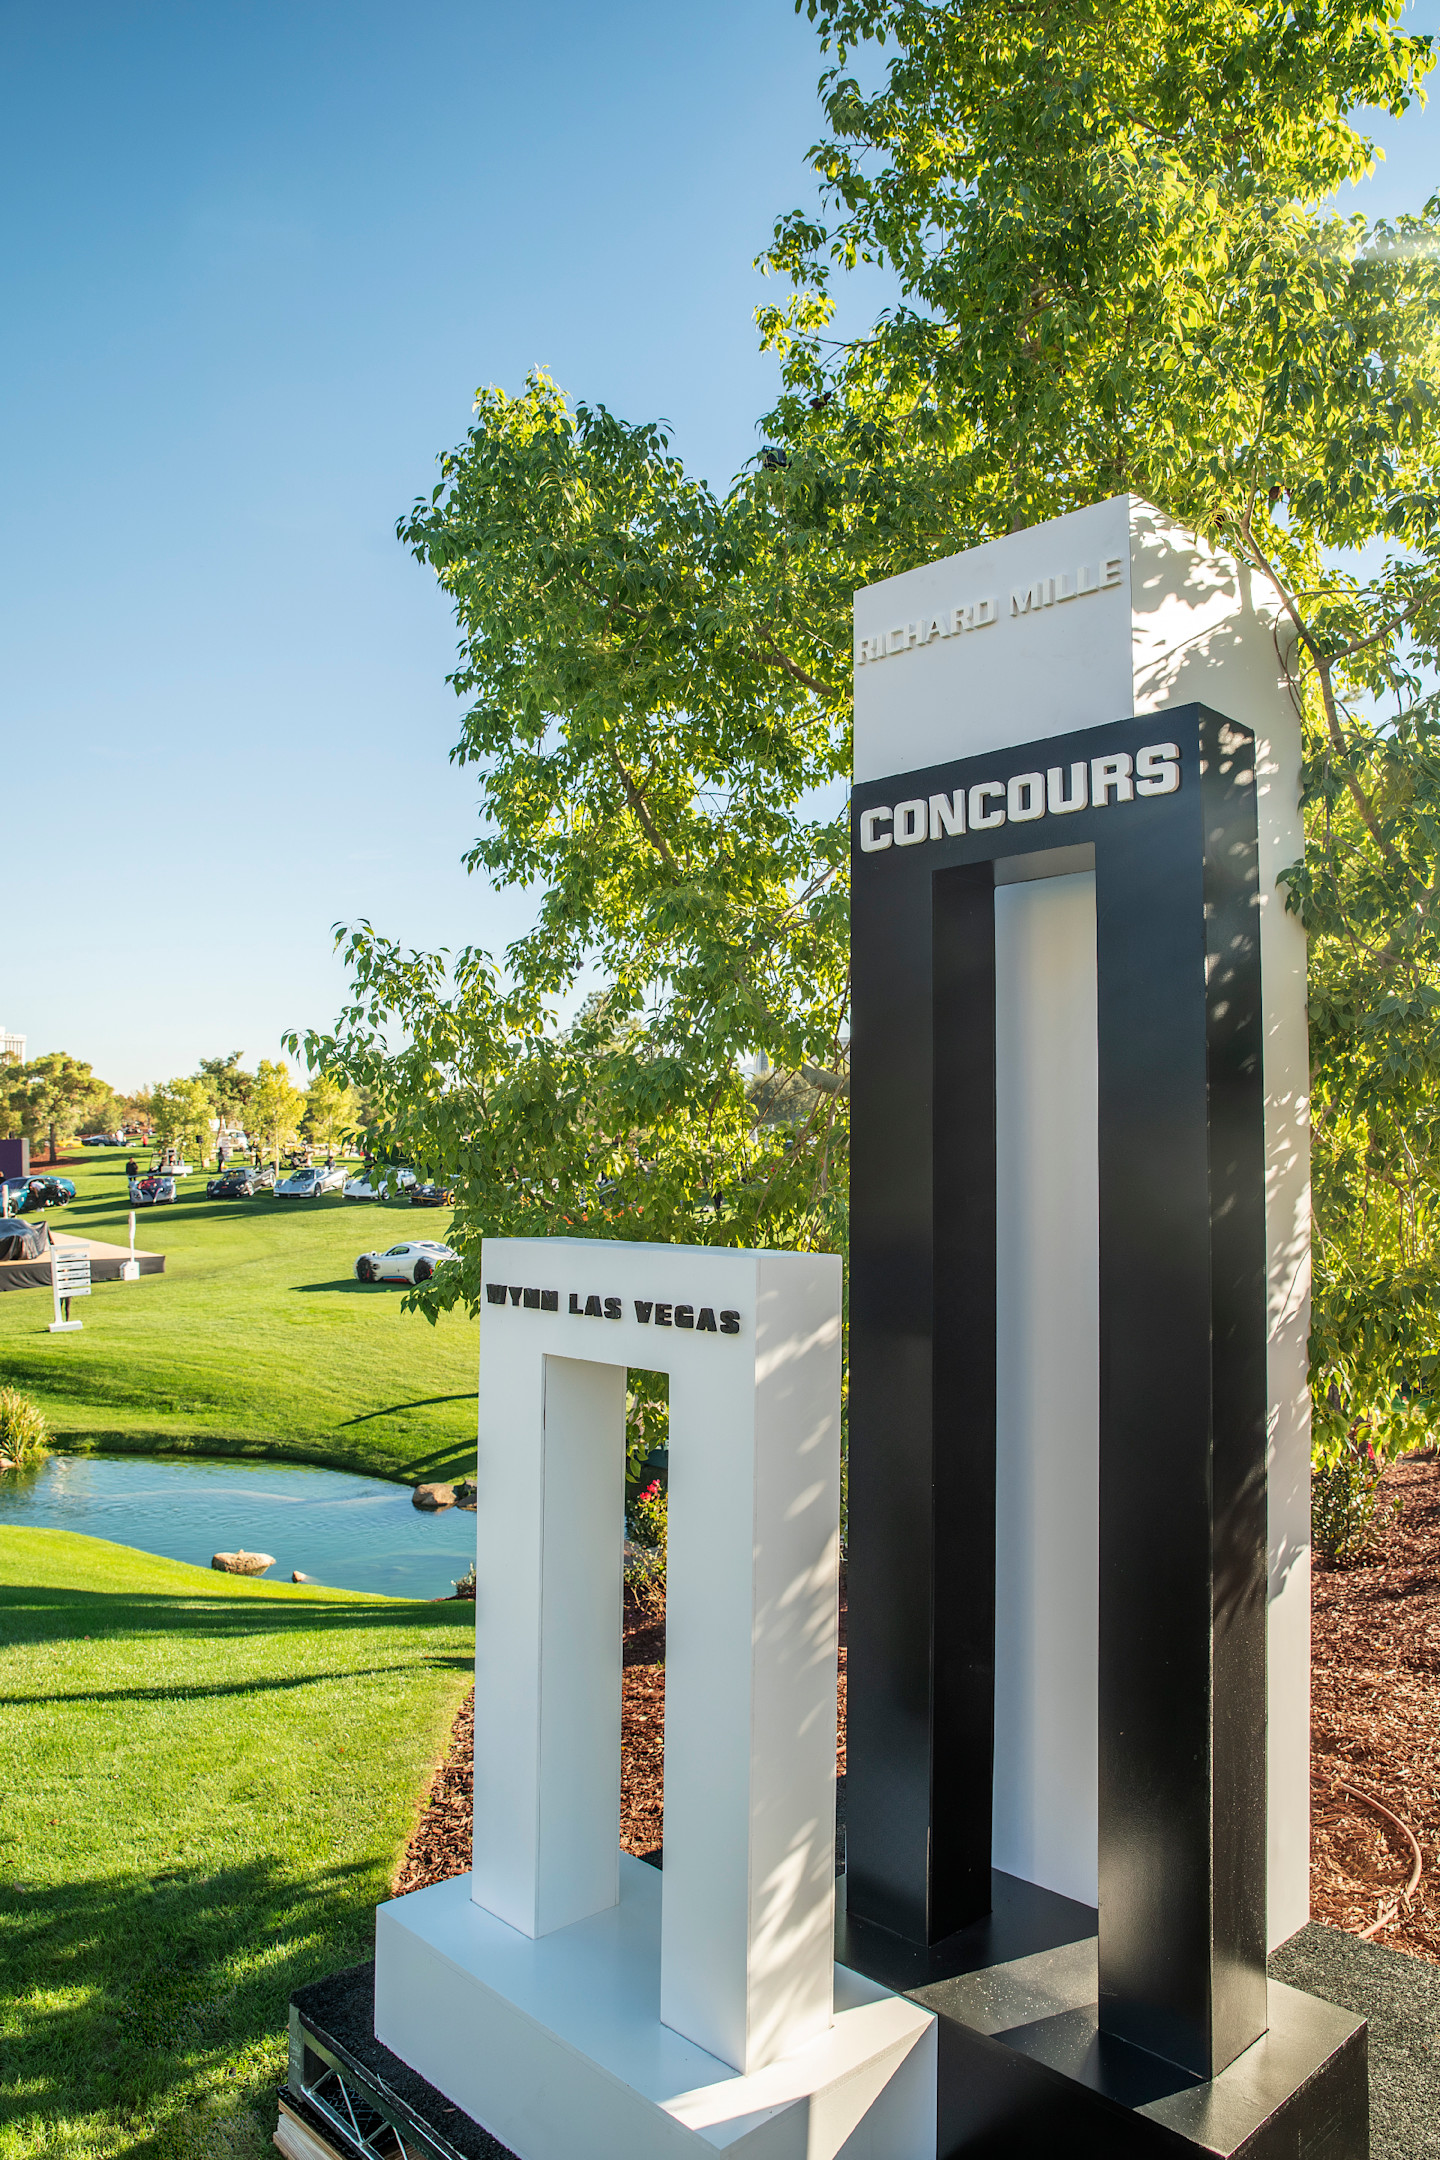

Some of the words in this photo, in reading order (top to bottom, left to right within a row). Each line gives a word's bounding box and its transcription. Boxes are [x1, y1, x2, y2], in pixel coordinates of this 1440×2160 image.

[856, 598, 998, 665] RICHARD
[1010, 557, 1123, 617] MILLE
[860, 743, 1180, 853] CONCOURS
[486, 1284, 559, 1312] WYNN
[568, 1293, 622, 1319] LAS
[634, 1300, 741, 1335] VEGAS
